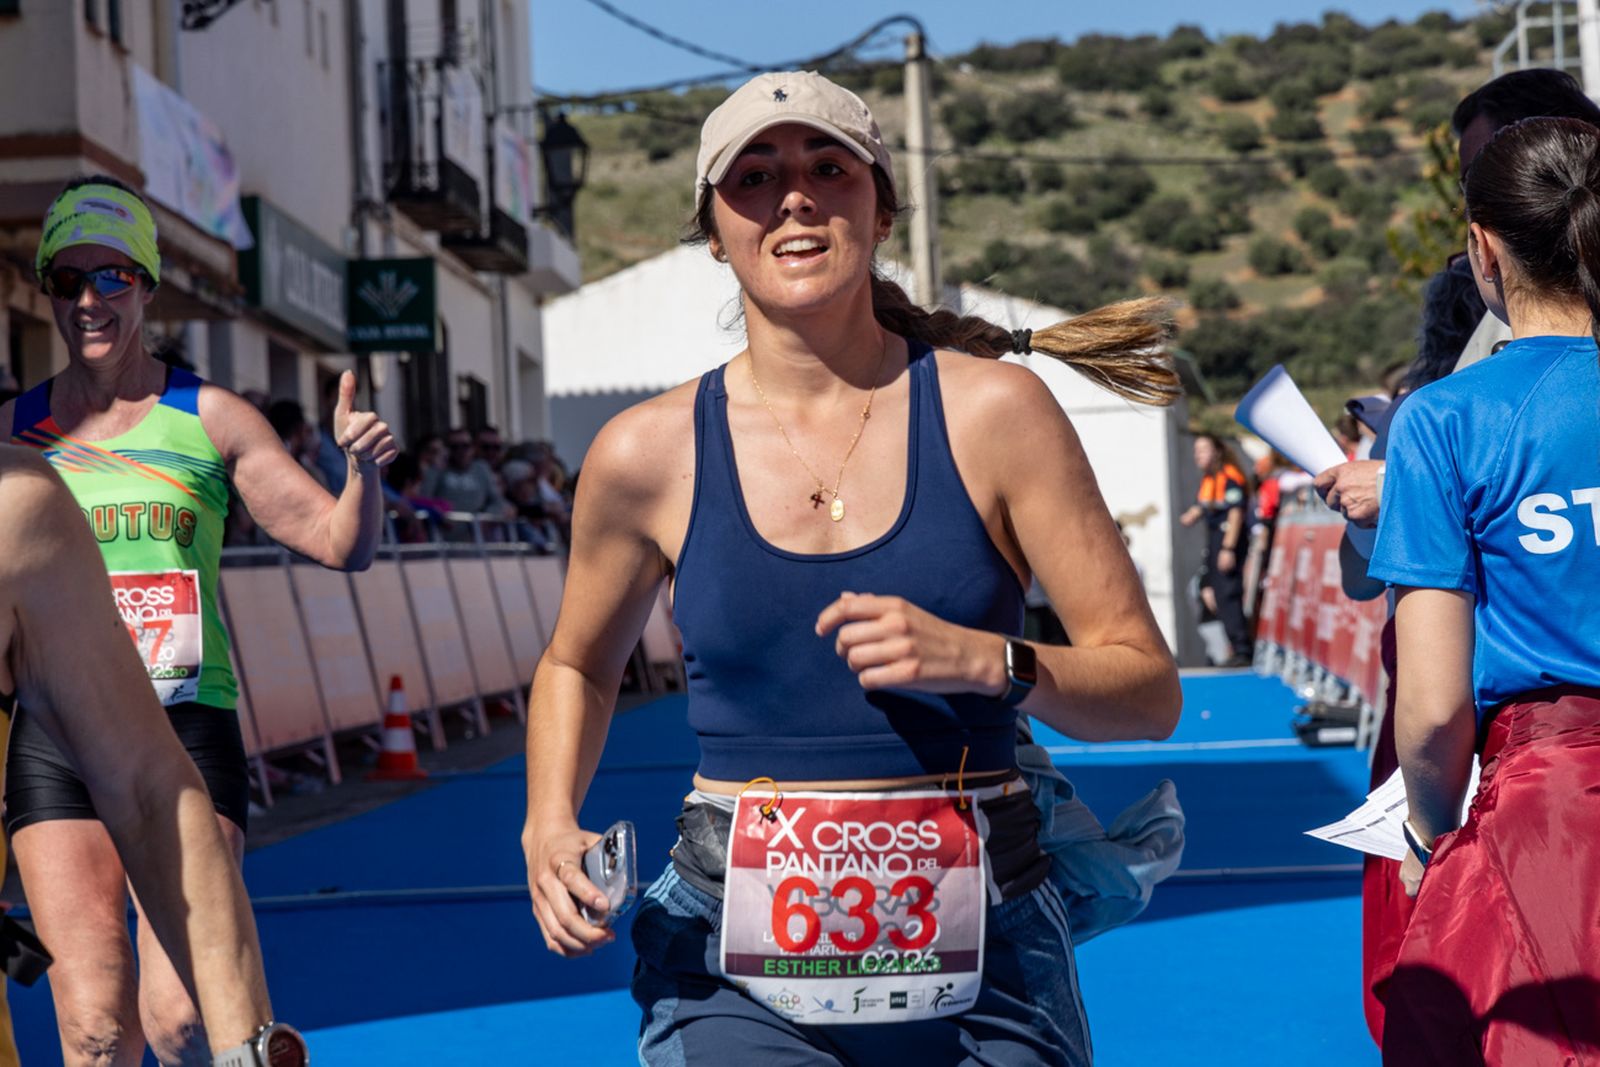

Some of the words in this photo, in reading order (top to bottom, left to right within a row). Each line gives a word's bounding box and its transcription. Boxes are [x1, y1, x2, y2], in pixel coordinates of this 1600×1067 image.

[81, 501, 198, 548] UTUS
[112, 586, 175, 606] ROSS
[766, 806, 807, 849] X
[811, 819, 942, 853] CROSS
[766, 851, 913, 880] PANTANO
[917, 857, 942, 871] DEL
[771, 875, 938, 953] 633
[763, 957, 842, 977] ESTHER
